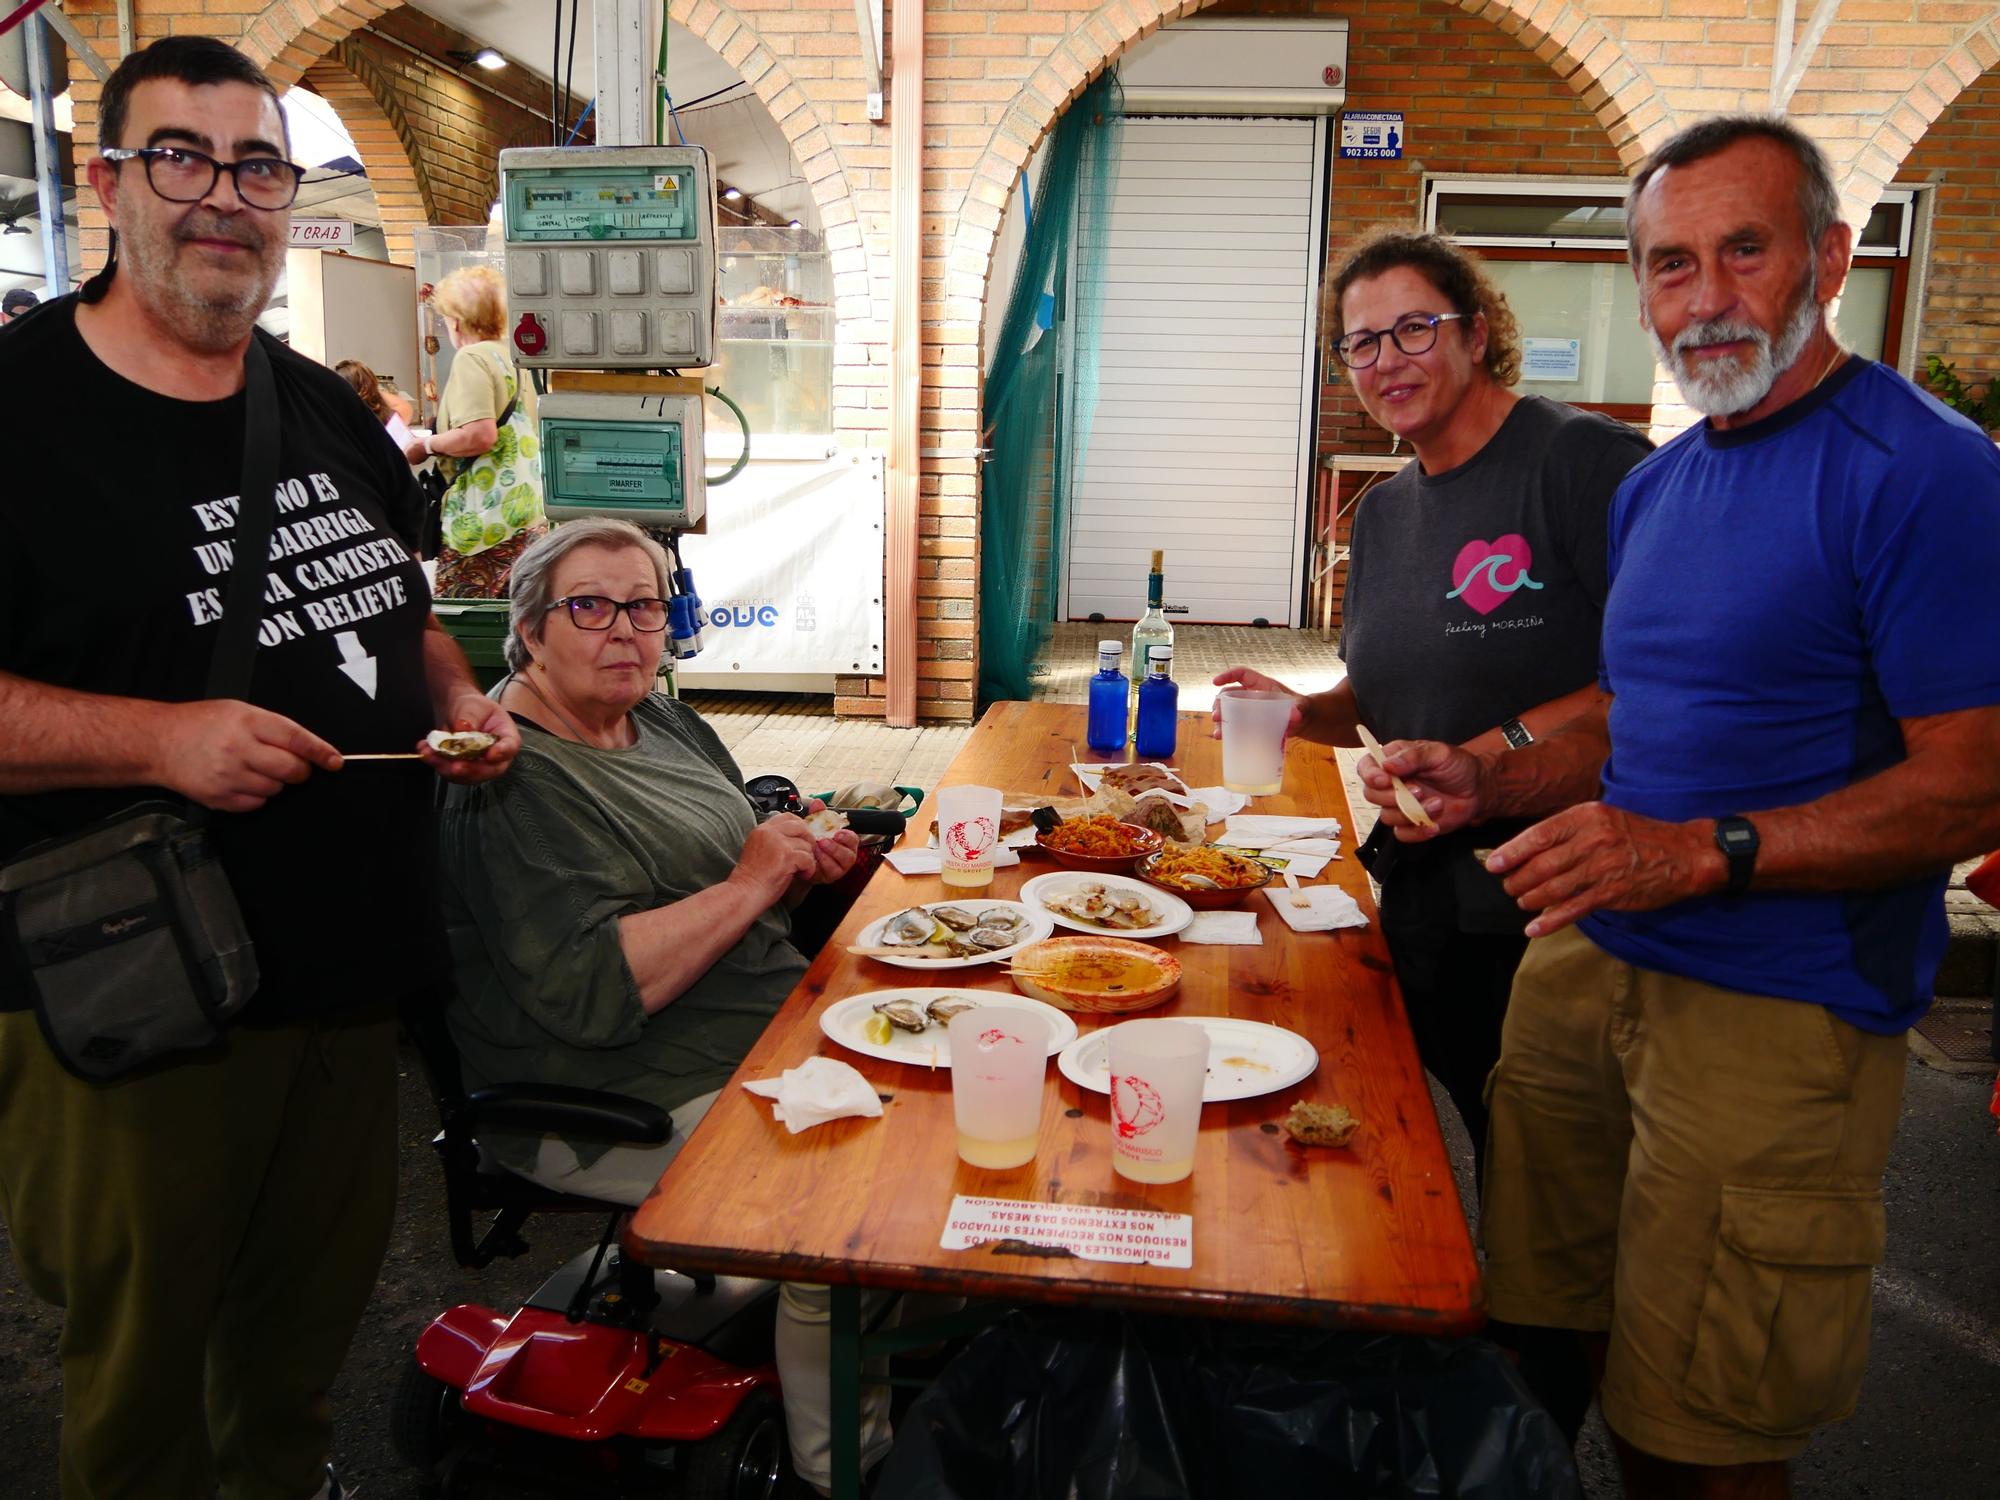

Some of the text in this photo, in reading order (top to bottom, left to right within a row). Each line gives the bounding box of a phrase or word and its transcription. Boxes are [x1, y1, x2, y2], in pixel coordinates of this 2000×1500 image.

[1344, 113, 1402, 121] ALARMACONECTADA
[1346, 148, 1396, 158] 902 365 000
[303, 226, 341, 240] CRAB
[192, 472, 340, 532] EST NO ES
[193, 507, 376, 575] UN BARRIGA
[186, 588, 224, 626] ES
[295, 537, 411, 592] CAMISETA
[258, 611, 305, 647] ON
[303, 575, 408, 632] RELIEVE
[1445, 615, 1545, 639] feeling MORRIÑA
[1096, 1208, 1128, 1216] POLA
[1131, 1211, 1181, 1221] GRAZAS
[1034, 1214, 1058, 1225] DAS
[1061, 1216, 1127, 1230] EXTREMOS
[1130, 1221, 1155, 1231] NOS
[951, 1220, 1187, 1247] RESIDUOS NOS RECIPIENTES SITUADOS
[1085, 1244, 1171, 1260] PEDIMOSLLES
